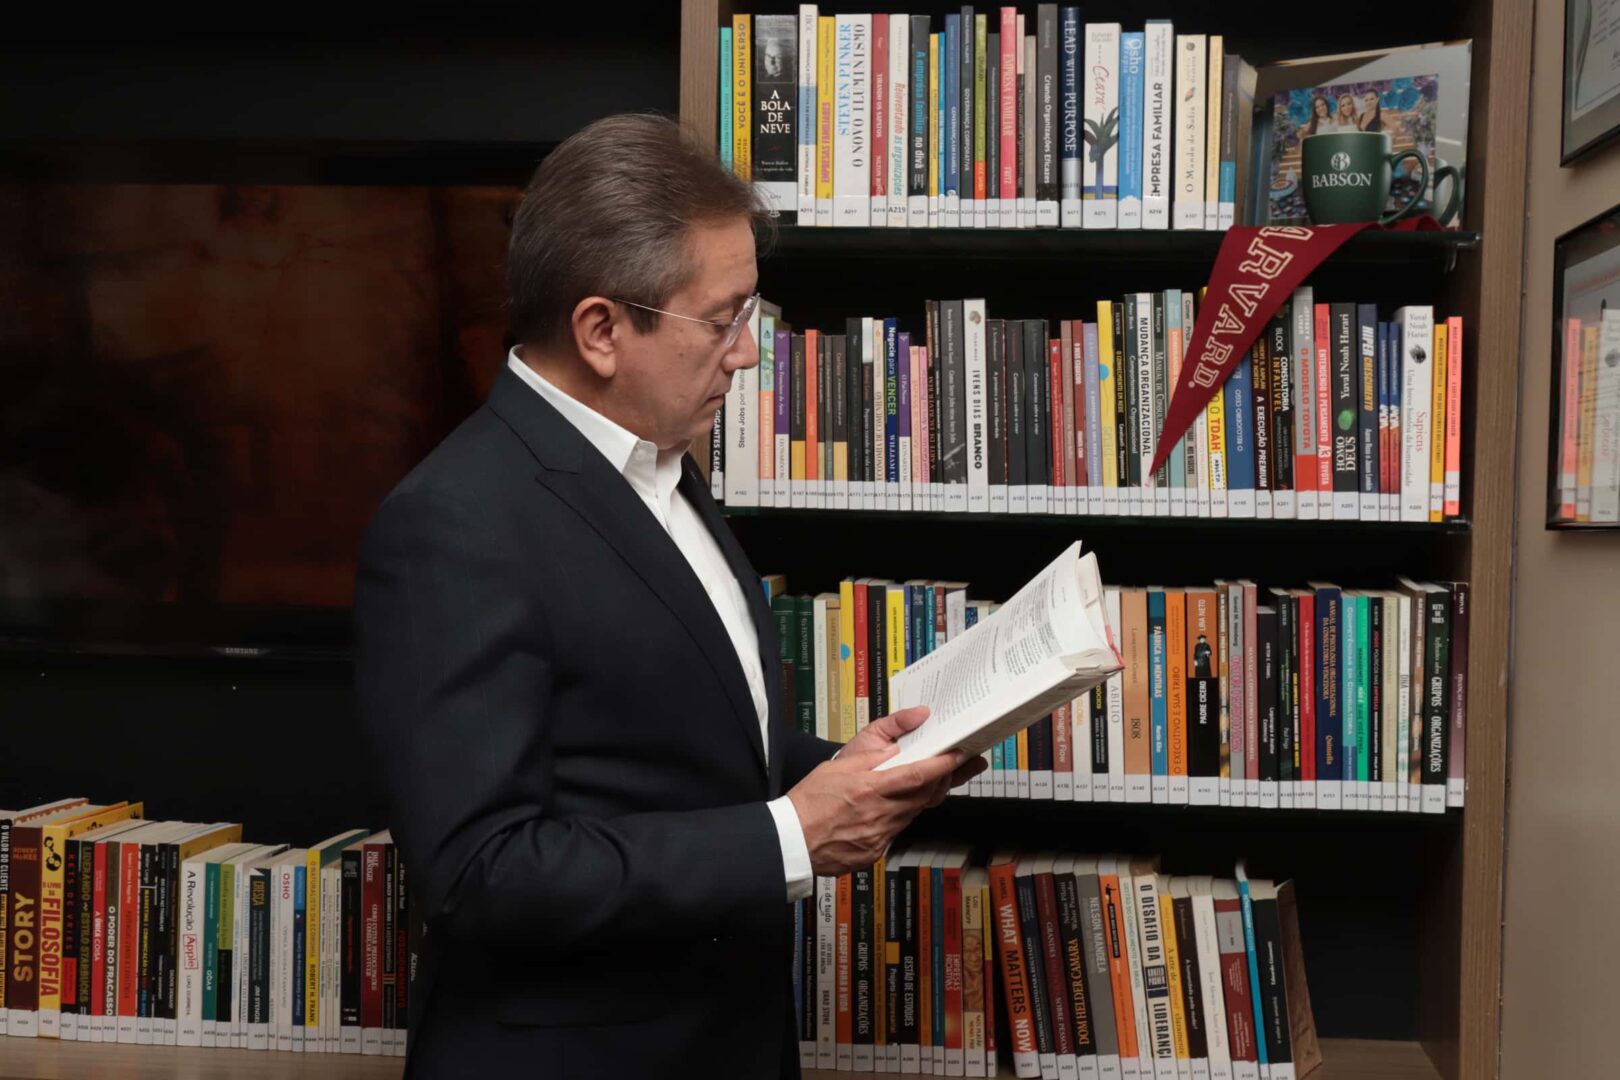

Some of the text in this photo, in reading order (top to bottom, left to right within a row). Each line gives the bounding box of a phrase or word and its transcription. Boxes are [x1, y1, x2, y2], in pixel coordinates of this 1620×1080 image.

[1129, 39, 1142, 73] Osho
[770, 90, 780, 99] A
[839, 24, 851, 135] STEVEN PINKER
[852, 24, 864, 167] O NOVO ILUMINISMO
[914, 60, 925, 98] empresa
[1002, 54, 1015, 136] EMPRESA FAMILIAR
[1065, 20, 1077, 152] LEAD WITH PURPOSE
[736, 101, 746, 128] VOCÊ
[761, 101, 791, 111] BOLA
[768, 112, 783, 122] DE
[915, 100, 926, 134] familiar
[1152, 83, 1162, 140] FAMILIAR
[760, 123, 791, 133] NEVE
[892, 83, 906, 196] Reinventando as organizações
[914, 137, 922, 149] no
[1044, 104, 1052, 152] Organizações
[822, 144, 830, 183] EMPRESAS
[915, 150, 925, 168] divã
[1312, 172, 1373, 188] BABSON
[1193, 228, 1337, 392] ARVARD
[886, 327, 897, 357] Negocie
[1408, 331, 1428, 339] Harari
[1319, 349, 1328, 388] ENTENDENDO
[1340, 313, 1350, 398] Yuval Noah Harari
[1363, 326, 1373, 411] HIPER CRESCIMENTO
[888, 376, 897, 415] VENCER
[1138, 318, 1151, 456] MUDANÇA ORGANIZACIONAL
[1302, 359, 1311, 404] MODELO
[1406, 386, 1414, 405] breve
[713, 409, 722, 448] GIGANTES
[972, 370, 982, 469] IVENS DIAS BRANCO
[1211, 418, 1221, 450] TDAH
[1256, 406, 1267, 447] EXECUÇÃO
[1302, 408, 1311, 449] TOYOTA
[1319, 399, 1328, 441] PENSAMENTO
[1404, 407, 1414, 435] história
[1414, 412, 1426, 452] Sapiens
[1318, 445, 1331, 458] A3
[1346, 437, 1355, 471] DEUS
[1405, 445, 1413, 486] humanidade
[1320, 461, 1328, 485] TOYOTA
[1198, 600, 1206, 631] LIRA NETO
[1154, 626, 1162, 654] FÁBRICA
[1154, 664, 1162, 698] MENTIRAS
[1173, 667, 1181, 690] TRIBO
[1400, 675, 1409, 688] DNA
[1111, 685, 1120, 723] ABILIO
[1173, 693, 1181, 709] SUA
[1199, 681, 1208, 724] PADRE CÍCERO
[1057, 706, 1067, 762] anaging Flow
[1131, 718, 1141, 739] 1808
[1173, 718, 1181, 765] EXECUTIVO
[1430, 677, 1442, 772] GRUPOS ORGANIZAÇÕES
[0, 853, 8, 864] DO
[252, 880, 264, 906] CRESÇA
[825, 893, 832, 903] de
[14, 892, 34, 982] STORY
[80, 847, 91, 1002] LIDERANDO ESTILO STARBUCKS
[184, 870, 196, 968] A Revolução Apple
[1088, 897, 1105, 973] NELSON MANDELA
[1142, 897, 1158, 944] DESAFIO
[41, 898, 60, 997] FILOSOFIA
[107, 950, 114, 964] DO
[1147, 947, 1159, 961] DA
[857, 942, 868, 1034] GRUPOS ORGANIZAÇÕES
[904, 956, 915, 1026] GESTÃO DE ESTOQUES
[1000, 904, 1032, 1052] WHAT MATTERS NOW
[1068, 939, 1090, 1045] DOM HELDER CAMARA
